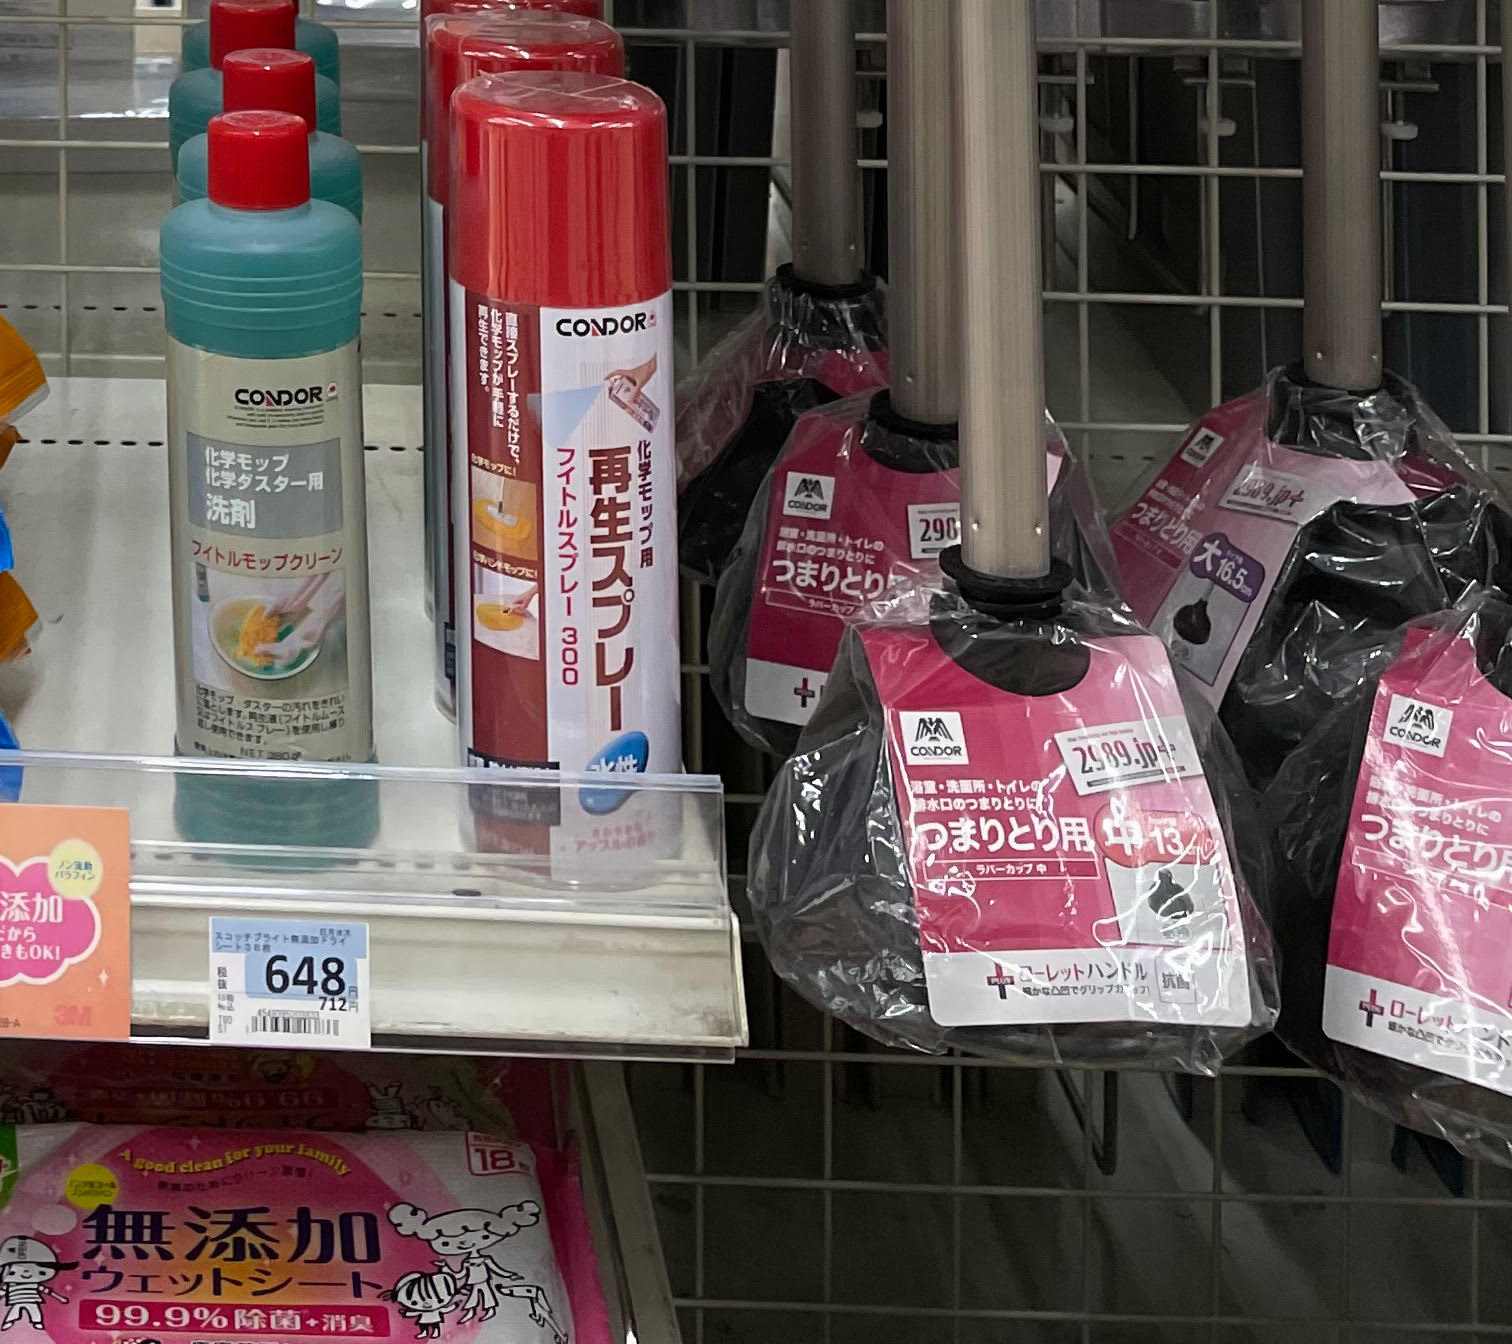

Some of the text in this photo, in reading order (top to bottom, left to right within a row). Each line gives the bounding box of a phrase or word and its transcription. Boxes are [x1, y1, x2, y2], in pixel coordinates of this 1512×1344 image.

[555, 311, 648, 338] CONDOR
[234, 385, 324, 408] CONDOR
[205, 446, 289, 473] 化学モップ
[205, 470, 324, 491] 化学ダスター用
[205, 494, 257, 530] 洗剤
[637, 439, 655, 569] 化学モップ用
[556, 448, 579, 617] フイトルスプレー
[191, 539, 344, 571] フイトルモップクリーン
[1192, 539, 1222, 573] 大
[588, 446, 636, 733] 再生スプレー
[910, 745, 962, 758] CONDOR
[915, 816, 1096, 853] つまりとり用
[975, 862, 1033, 876] ラバーカップ
[179, 1155, 224, 1174] clean
[225, 1148, 251, 1169] for
[82, 1204, 383, 1264] 無添加
[80, 1265, 384, 1298] ウェットシート
